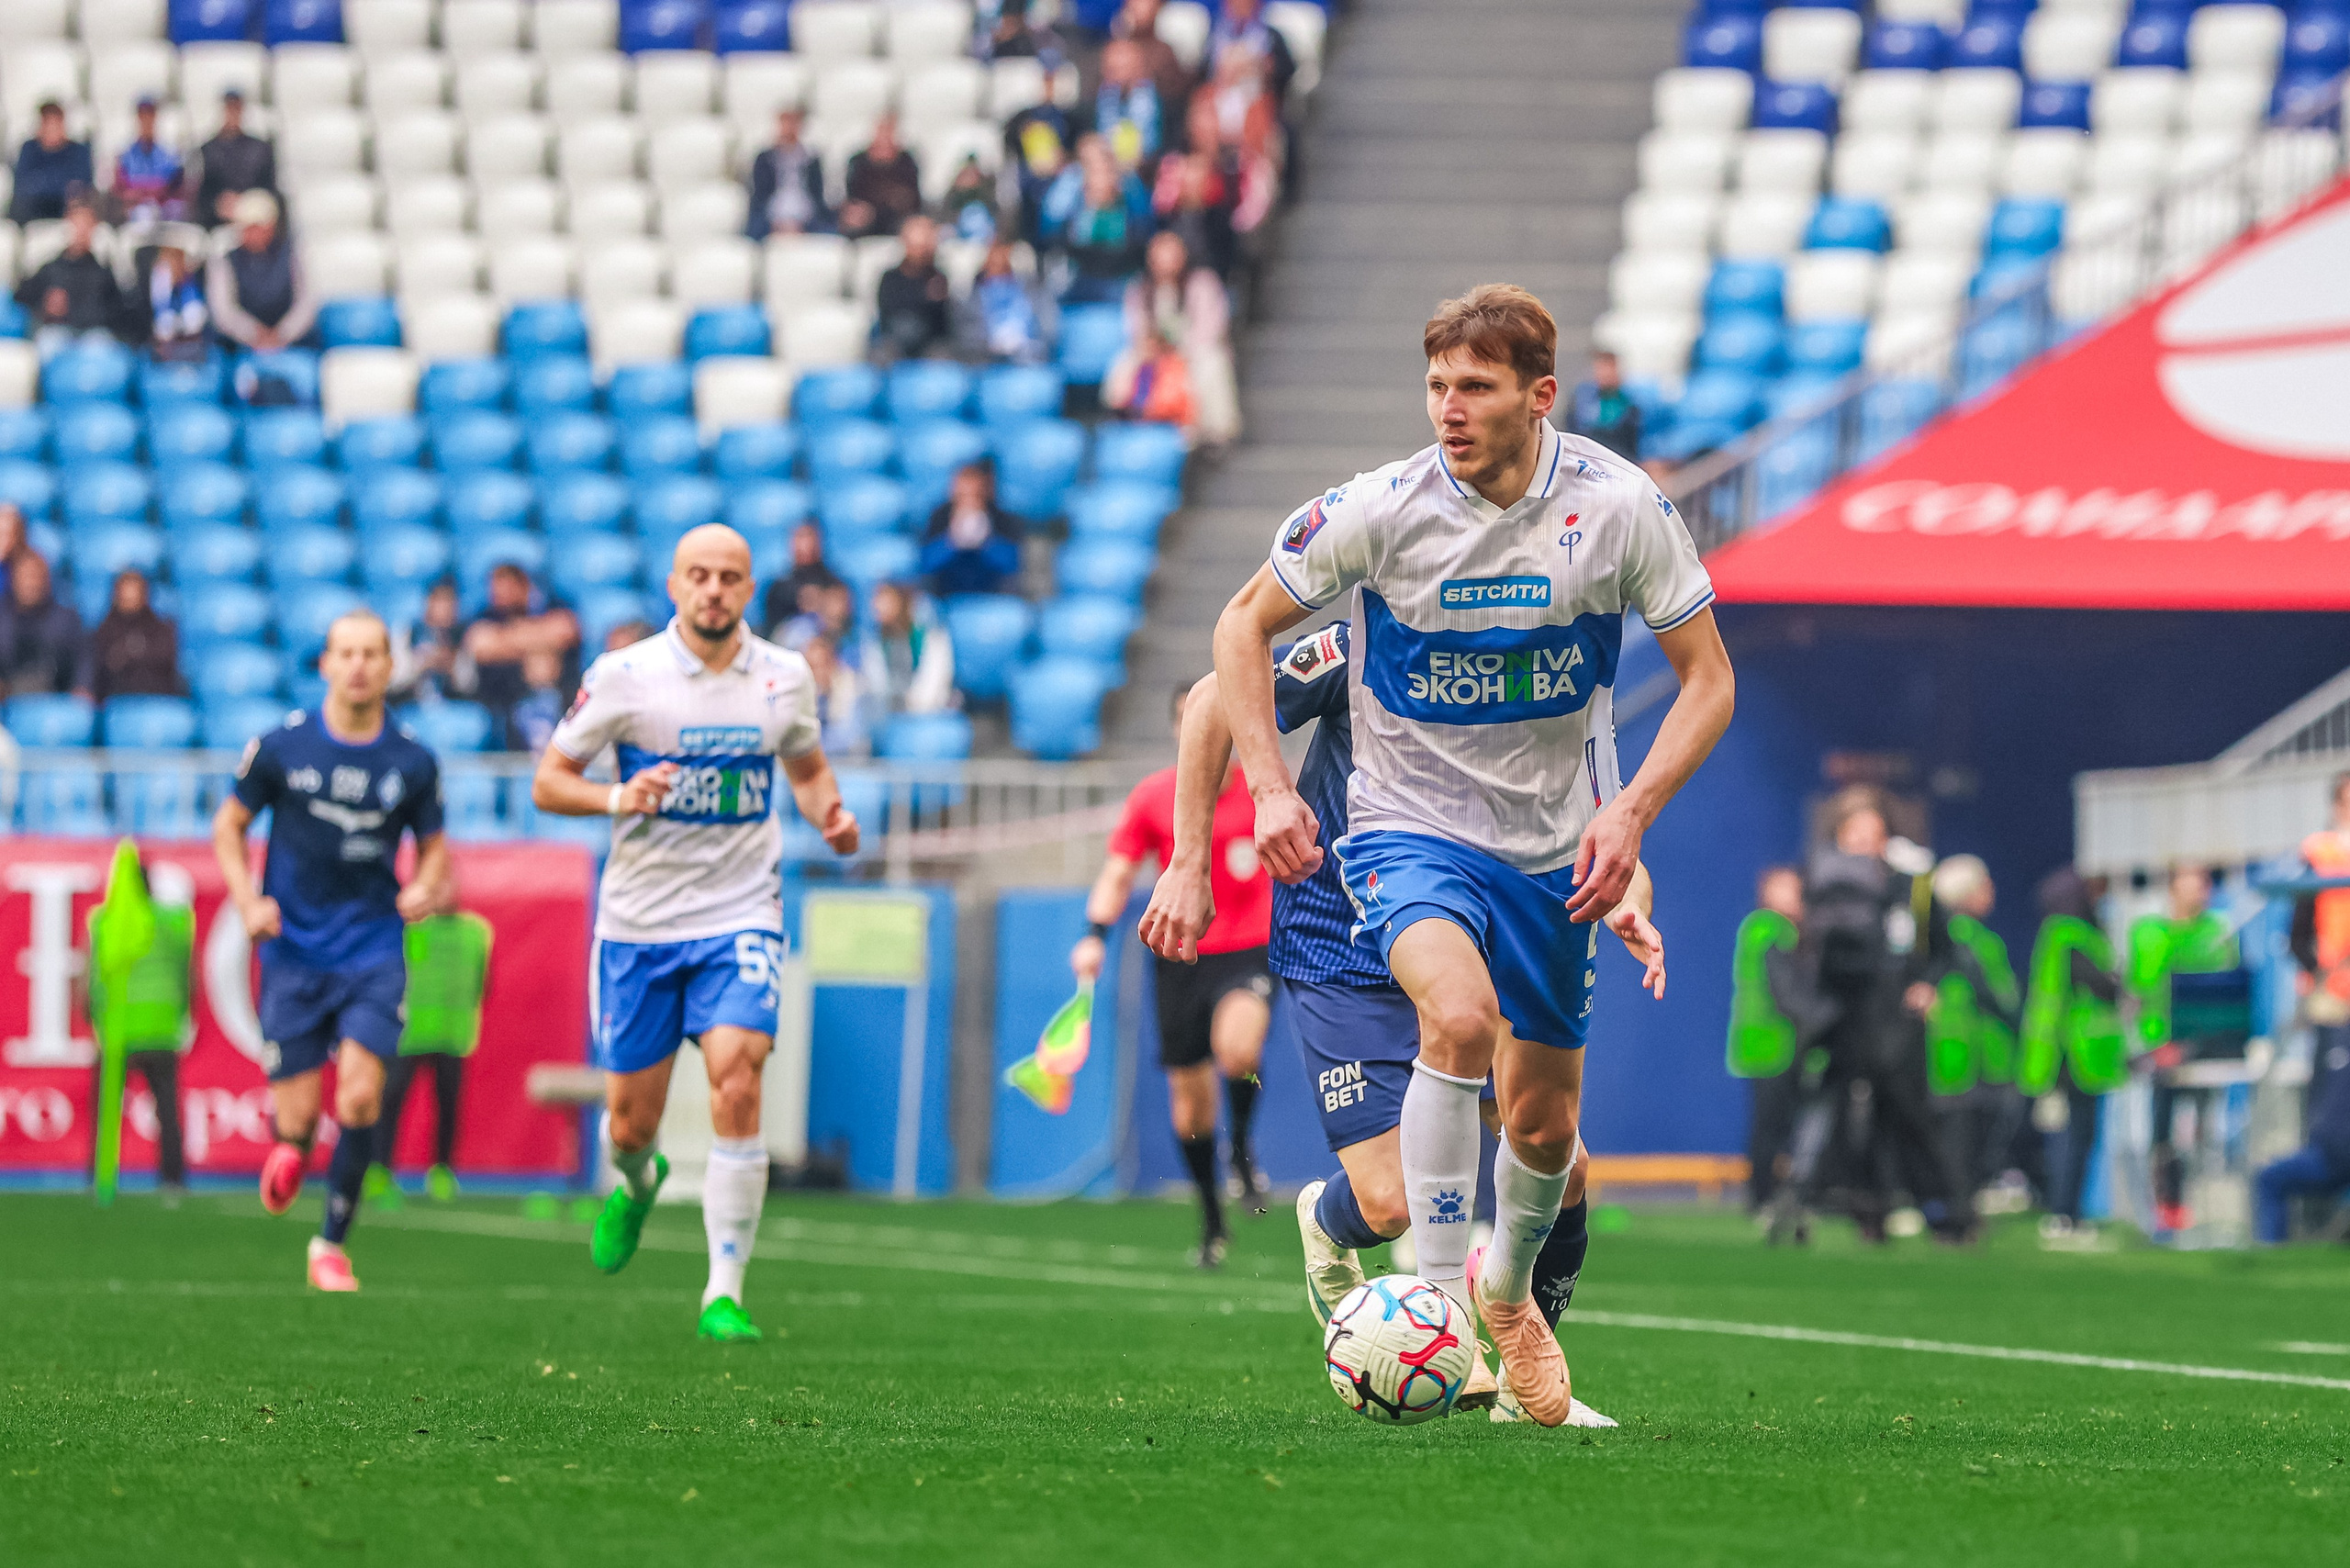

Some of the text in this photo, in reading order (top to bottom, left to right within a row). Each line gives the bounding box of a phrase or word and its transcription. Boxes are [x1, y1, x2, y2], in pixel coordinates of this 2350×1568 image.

[1443, 584, 1548, 602] БЕТСИТИ
[1429, 644, 1584, 677] EKONIVA
[1407, 672, 1578, 704] ЭКОНИВА
[1318, 1060, 1361, 1093] FON
[1325, 1080, 1368, 1114] BET
[1428, 1213, 1467, 1225] KELME
